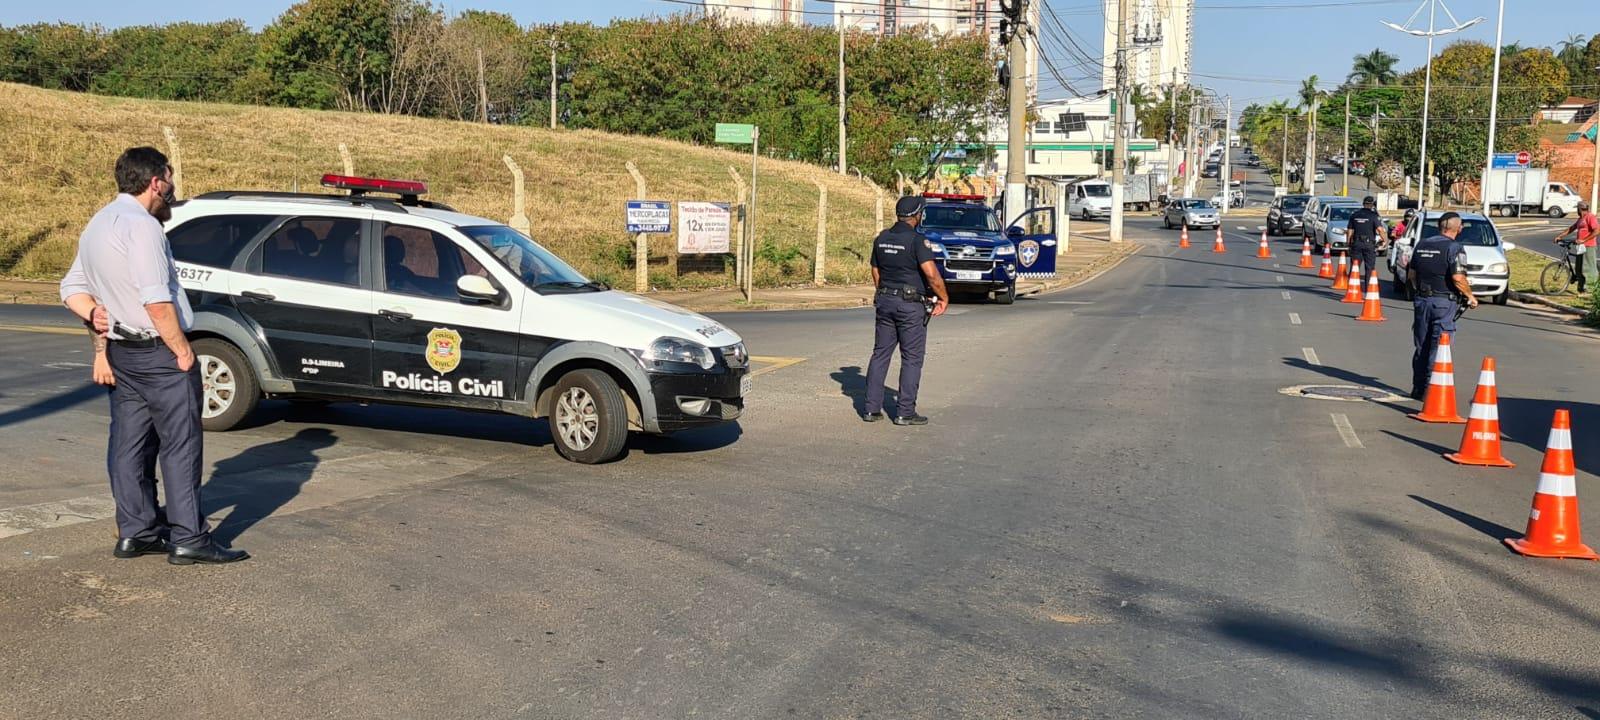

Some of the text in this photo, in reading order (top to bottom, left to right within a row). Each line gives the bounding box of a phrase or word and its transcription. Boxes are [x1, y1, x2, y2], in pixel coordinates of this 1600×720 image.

[686, 219, 704, 232] 12x
[382, 370, 504, 397] Polícia Civil
